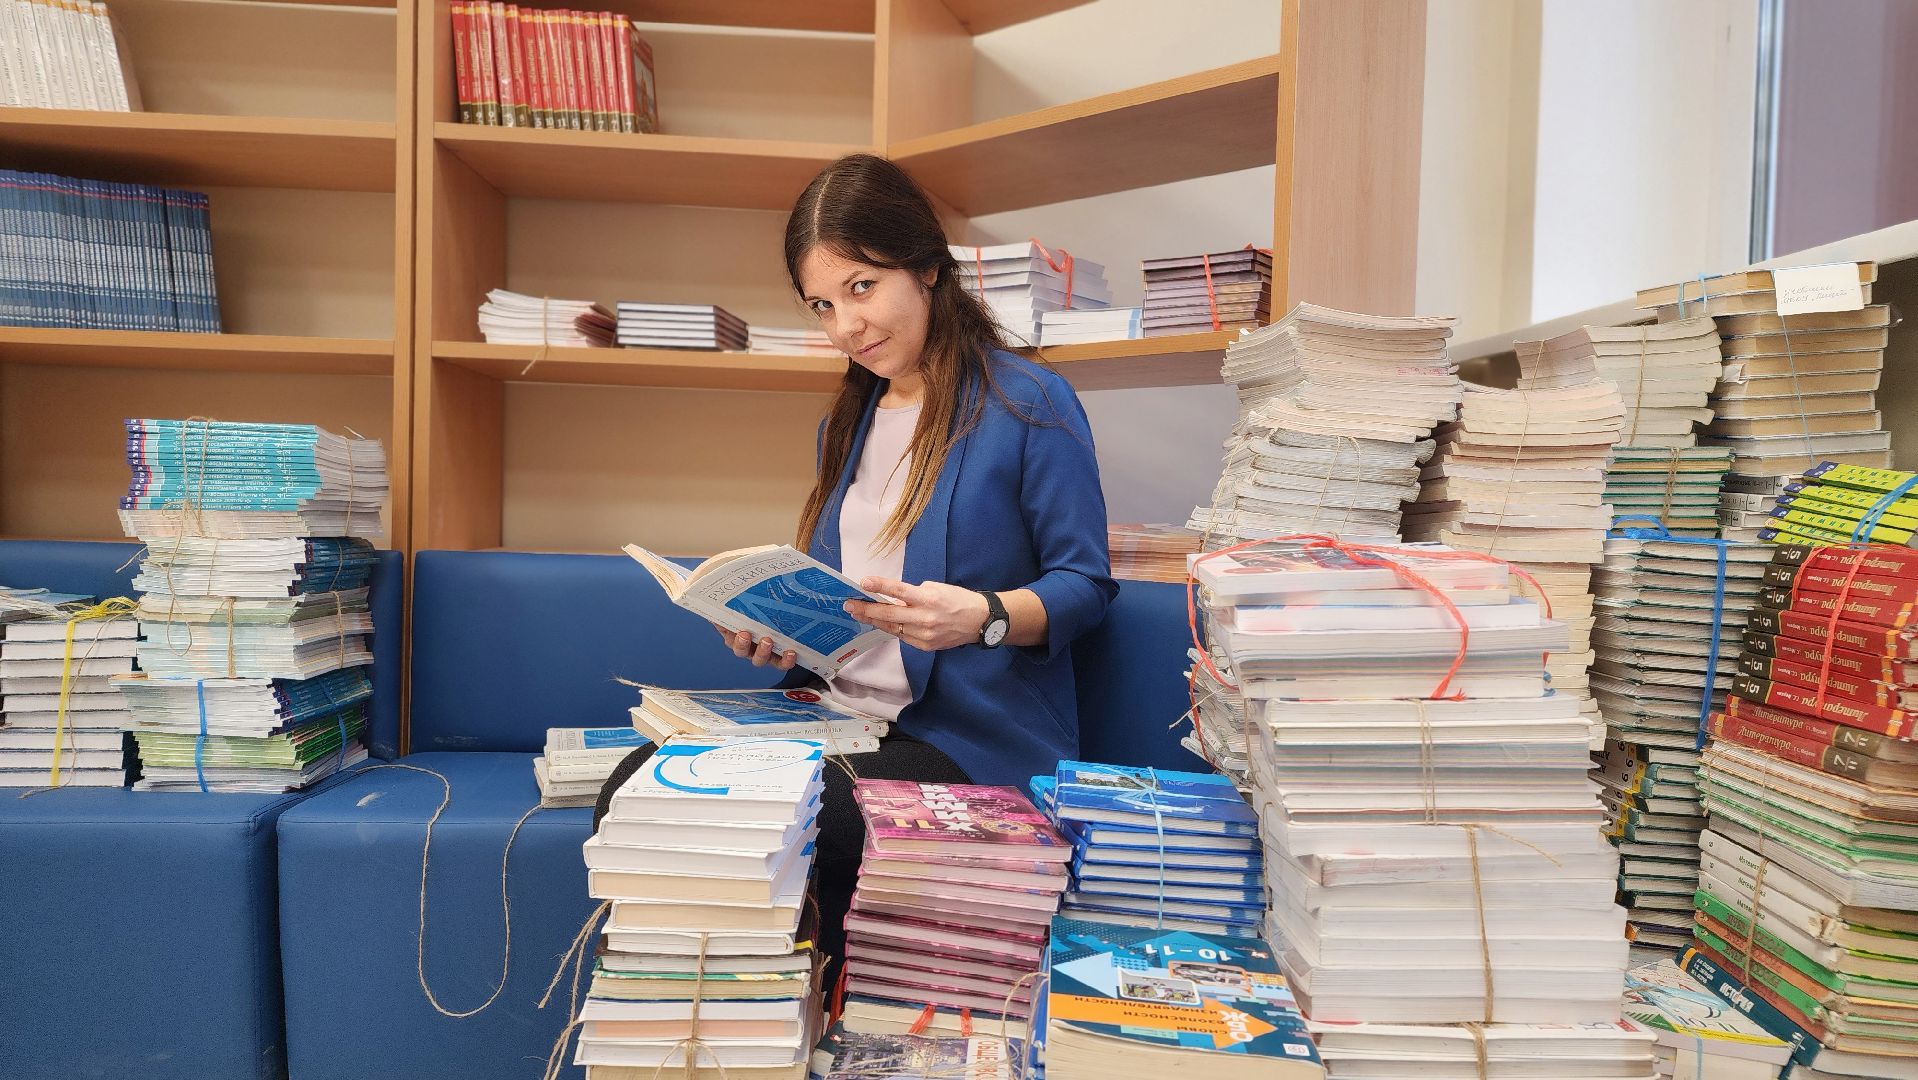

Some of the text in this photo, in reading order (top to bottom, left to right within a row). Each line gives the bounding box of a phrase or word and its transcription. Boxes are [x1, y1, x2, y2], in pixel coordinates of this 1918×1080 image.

[1840, 554, 1905, 573] Литераура
[1831, 577, 1897, 596] Литераура
[1820, 599, 1881, 618] Литераура
[1810, 624, 1868, 648] Литертура
[1803, 649, 1863, 673] Литертура
[1799, 671, 1859, 695] Литертура
[1801, 696, 1869, 722] Литераура
